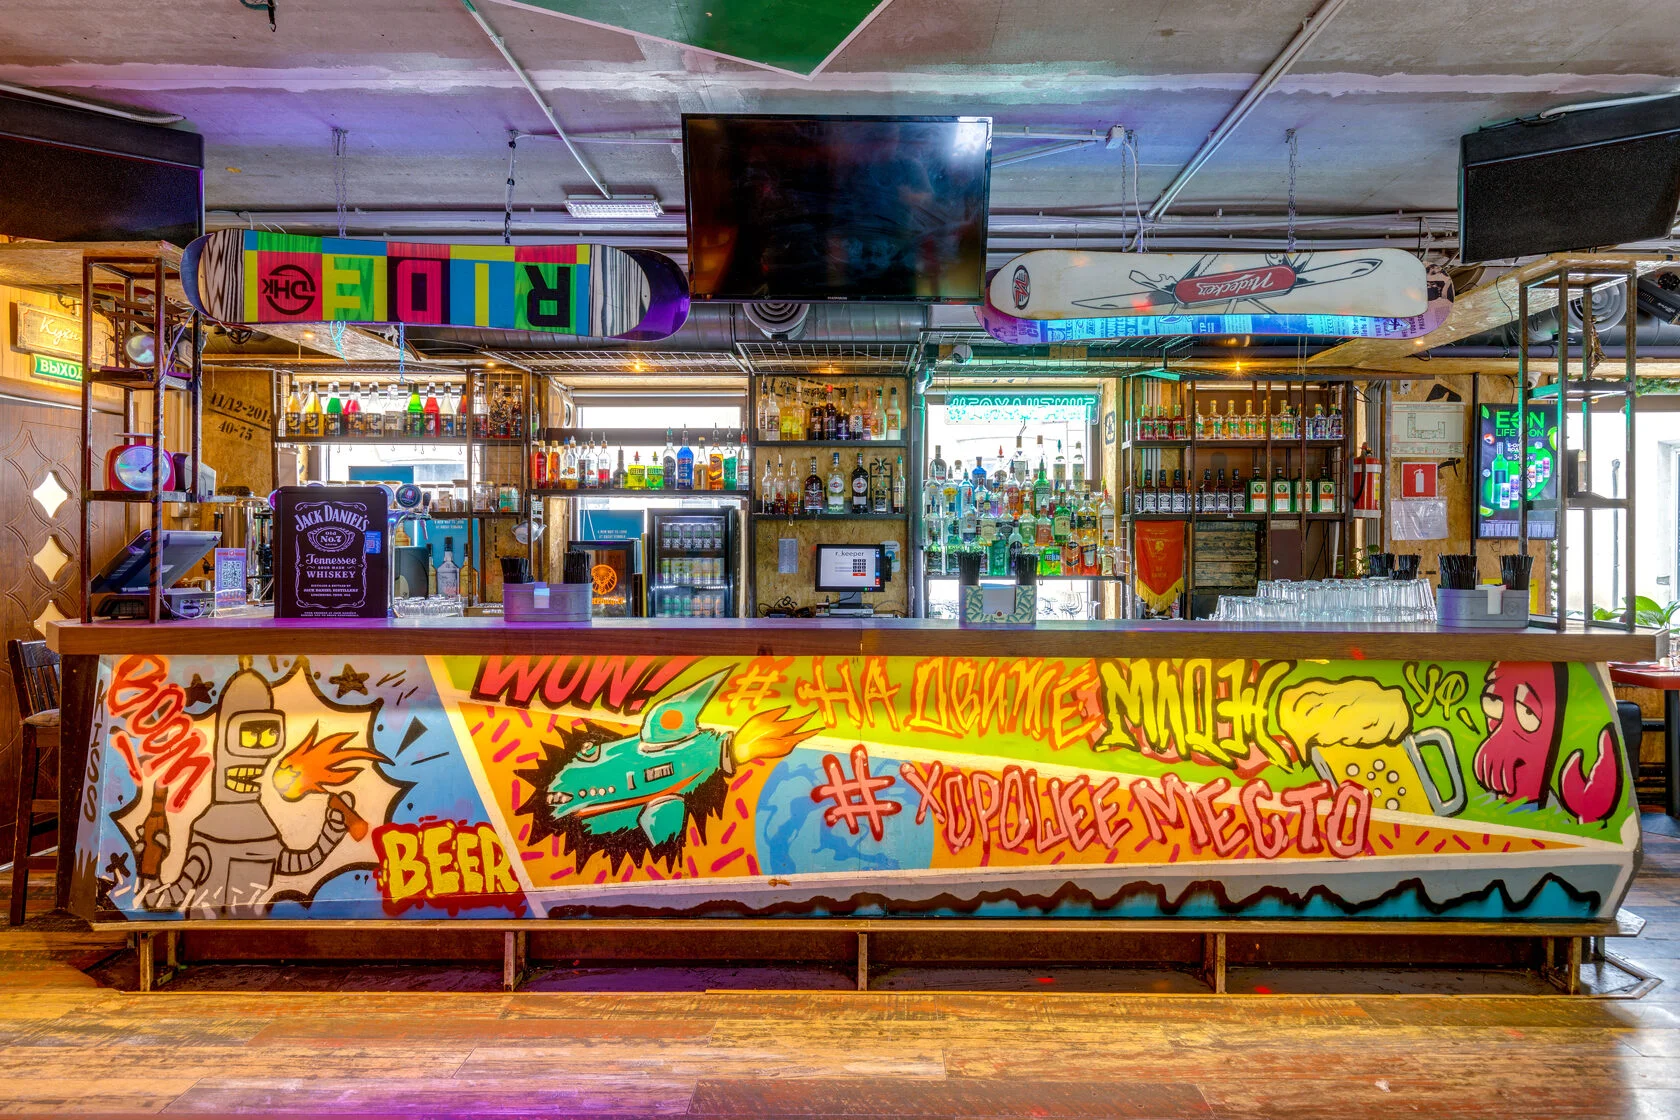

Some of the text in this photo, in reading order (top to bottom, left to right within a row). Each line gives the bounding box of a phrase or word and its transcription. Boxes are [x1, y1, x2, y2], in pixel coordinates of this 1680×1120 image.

[334, 257, 571, 328] RIDE
[1196, 271, 1275, 297] Nidecker
[39, 315, 83, 345] Кухн
[219, 420, 254, 441] 40-75
[1496, 429, 1545, 437] LIFE ON
[294, 504, 370, 532] JACK DANIEL'S
[320, 535, 342, 543] No.7
[305, 553, 357, 565] Tennessee
[306, 570, 356, 578] WHISKEY
[378, 822, 523, 905] BEER
